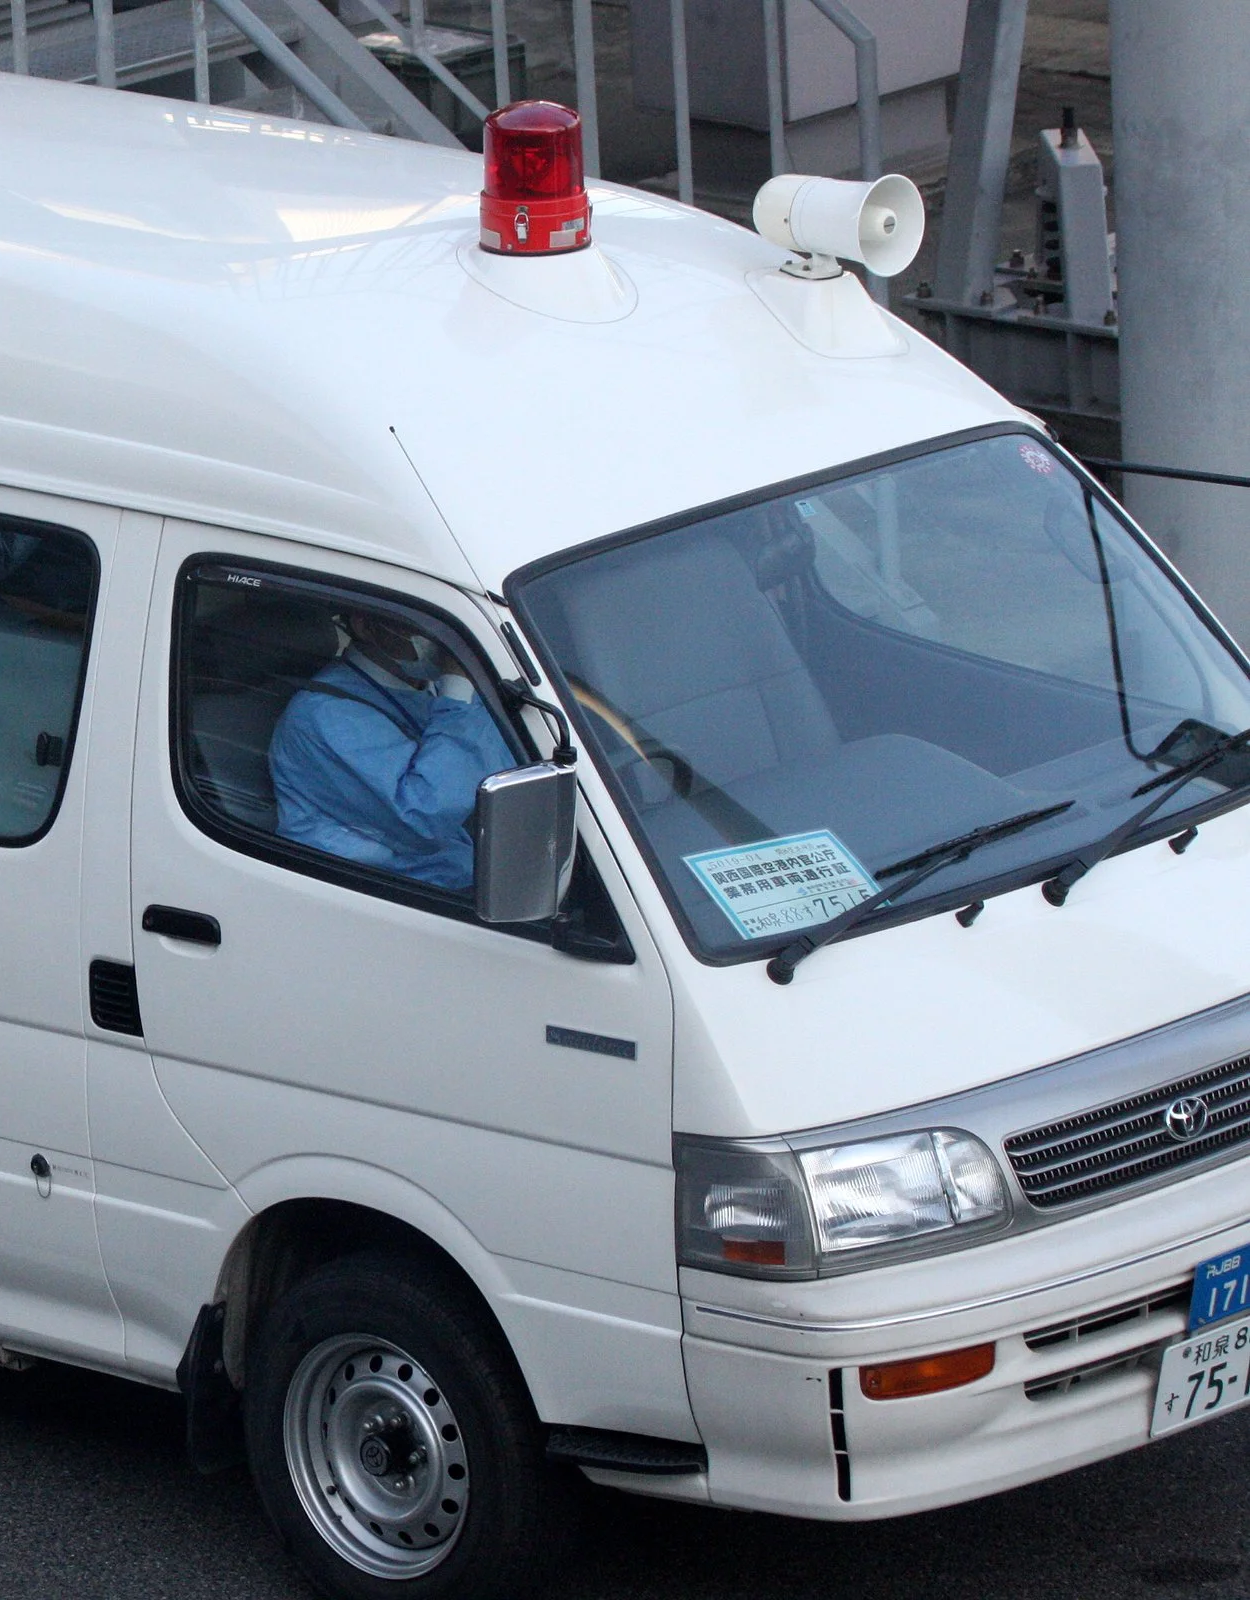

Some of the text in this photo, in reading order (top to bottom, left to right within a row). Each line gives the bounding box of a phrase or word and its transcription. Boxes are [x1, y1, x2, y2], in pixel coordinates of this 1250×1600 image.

[227, 573, 262, 587] HIACE
[1208, 1273, 1249, 1318] 171
[1193, 1335, 1230, 1366] 和泉
[1164, 1392, 1180, 1415] す
